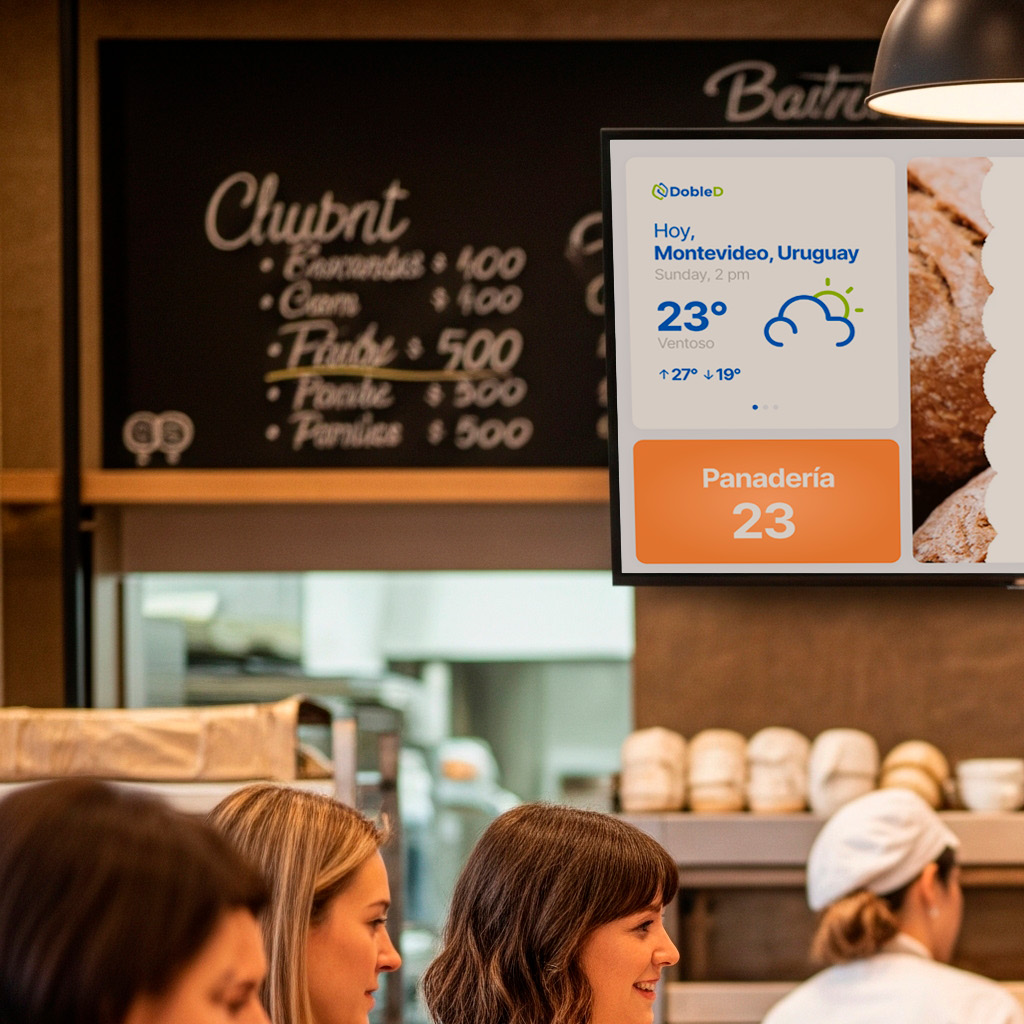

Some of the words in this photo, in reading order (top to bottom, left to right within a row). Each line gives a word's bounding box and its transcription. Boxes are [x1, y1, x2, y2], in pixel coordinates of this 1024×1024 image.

[669, 185, 724, 198] DobleD
[654, 222, 695, 242] Hoy,
[654, 244, 774, 264] Montevideo,
[777, 245, 860, 264] Uruguay
[654, 268, 711, 284] Sunday,
[714, 268, 724, 281] 2
[727, 270, 750, 284] pm
[657, 300, 728, 332] 23°
[437, 328, 524, 373] 500
[657, 337, 715, 350] Ventoso
[671, 367, 698, 381] 27°
[715, 367, 742, 381] 19°
[702, 466, 835, 489] Panadería
[732, 501, 796, 540] 23
